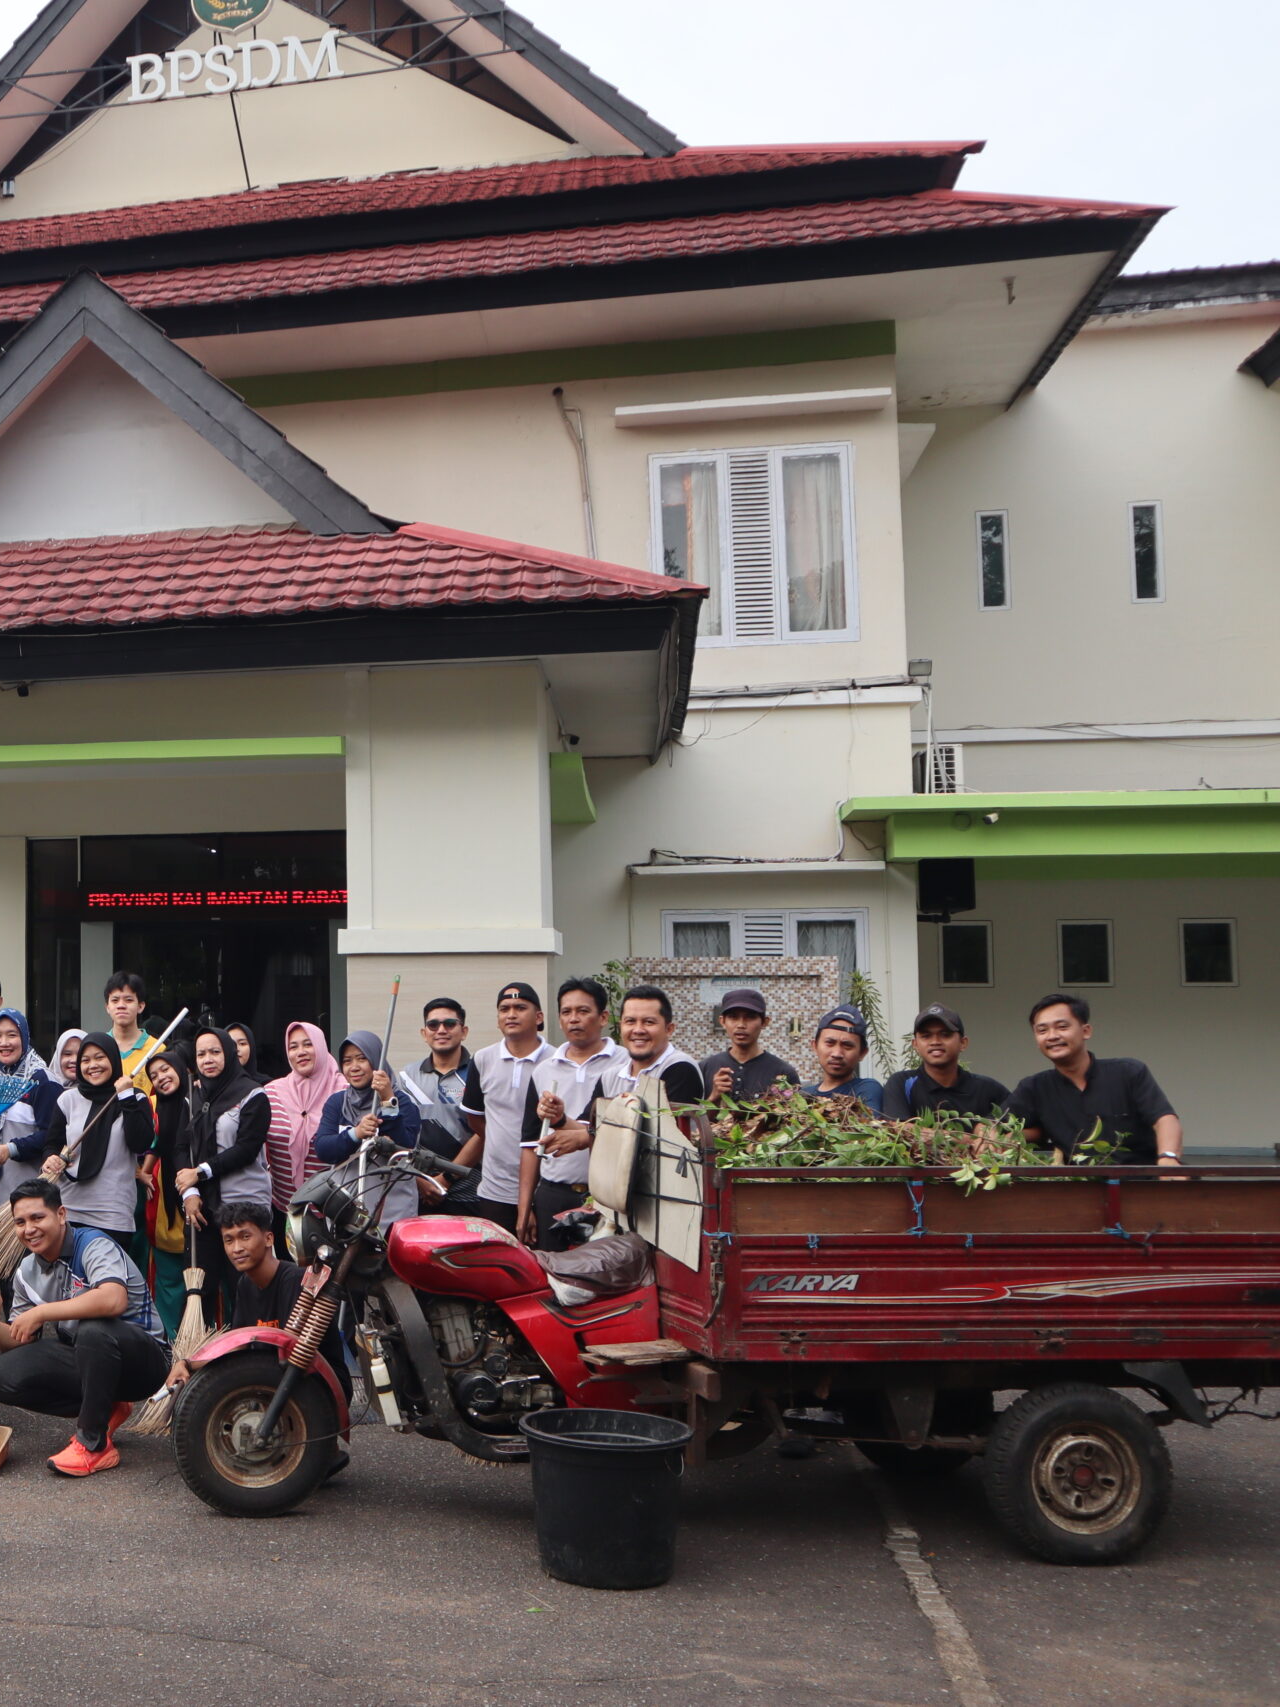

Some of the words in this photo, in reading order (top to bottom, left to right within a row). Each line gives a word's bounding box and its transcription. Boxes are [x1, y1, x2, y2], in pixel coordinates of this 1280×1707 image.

[125, 29, 345, 103] BPSDM
[88, 892, 169, 907] PROVINSI
[744, 1274, 860, 1292] KARYA
